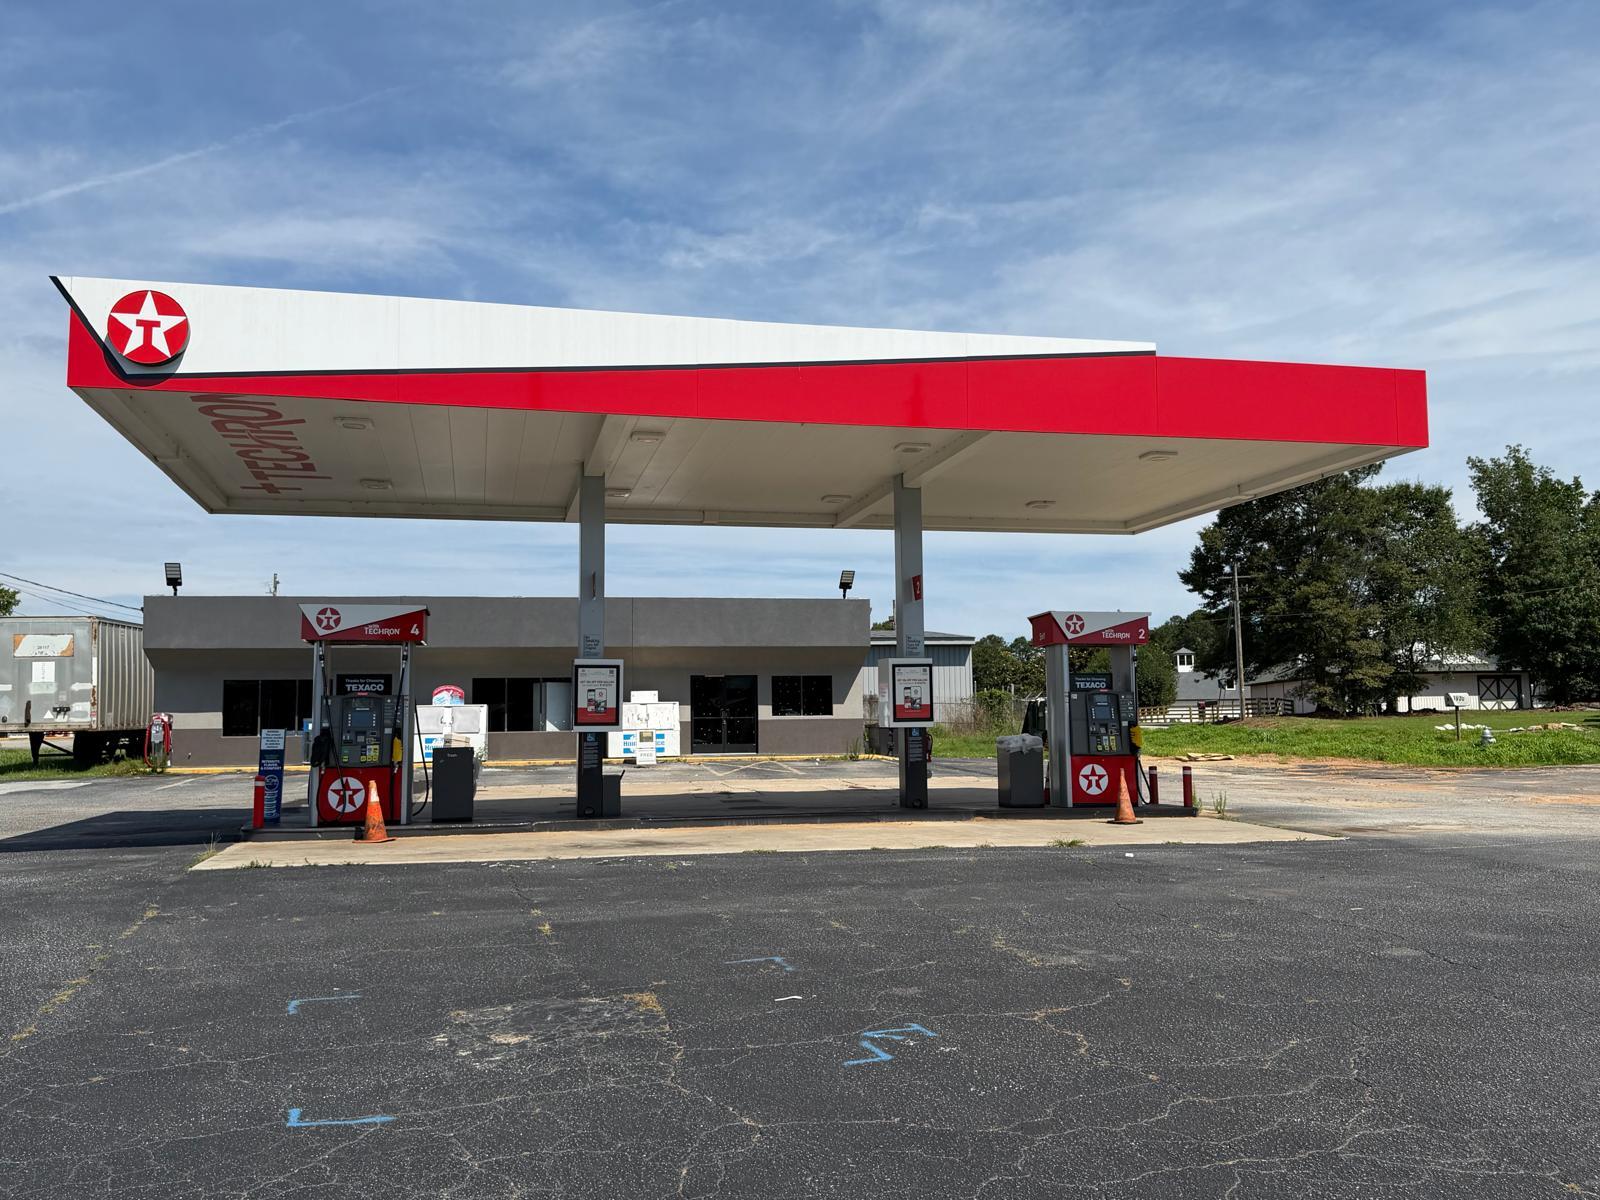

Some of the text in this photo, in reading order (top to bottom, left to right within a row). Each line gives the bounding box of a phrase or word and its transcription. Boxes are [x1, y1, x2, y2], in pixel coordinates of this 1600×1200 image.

[364, 627, 400, 636] TECHRON
[410, 624, 420, 635] 4
[1138, 629, 1146, 639] 2
[1102, 631, 1130, 639] TECHRON
